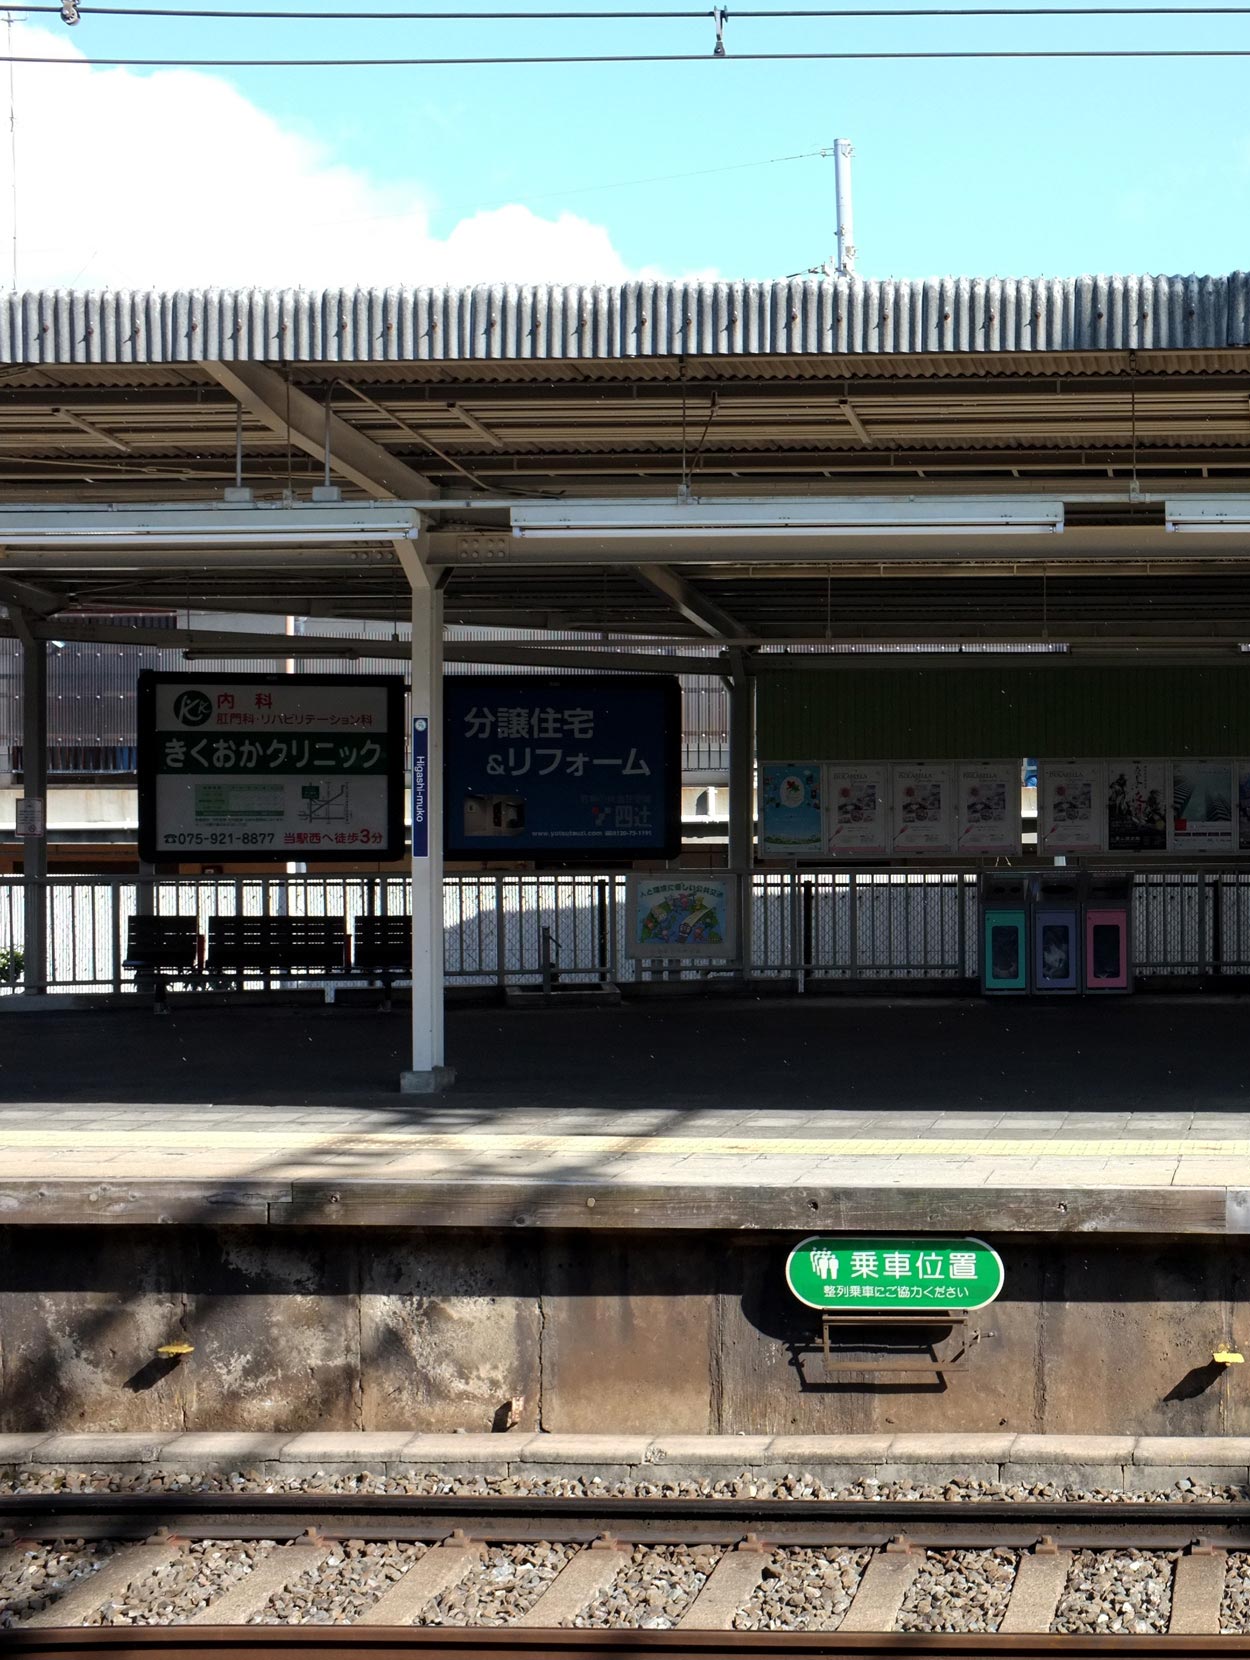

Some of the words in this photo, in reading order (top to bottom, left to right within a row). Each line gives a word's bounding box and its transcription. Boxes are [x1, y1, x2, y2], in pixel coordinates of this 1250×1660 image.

[464, 707, 594, 739] 分譲住宅
[164, 738, 382, 769] きくおかクリニック
[415, 756, 425, 823] Higashi-muko
[178, 833, 275, 845] 075-921-8877
[283, 829, 383, 845] 当駅西へ徒歩3分
[850, 1251, 978, 1280] 乗車位置
[823, 1285, 969, 1298] 整列乗車にご協力ください
